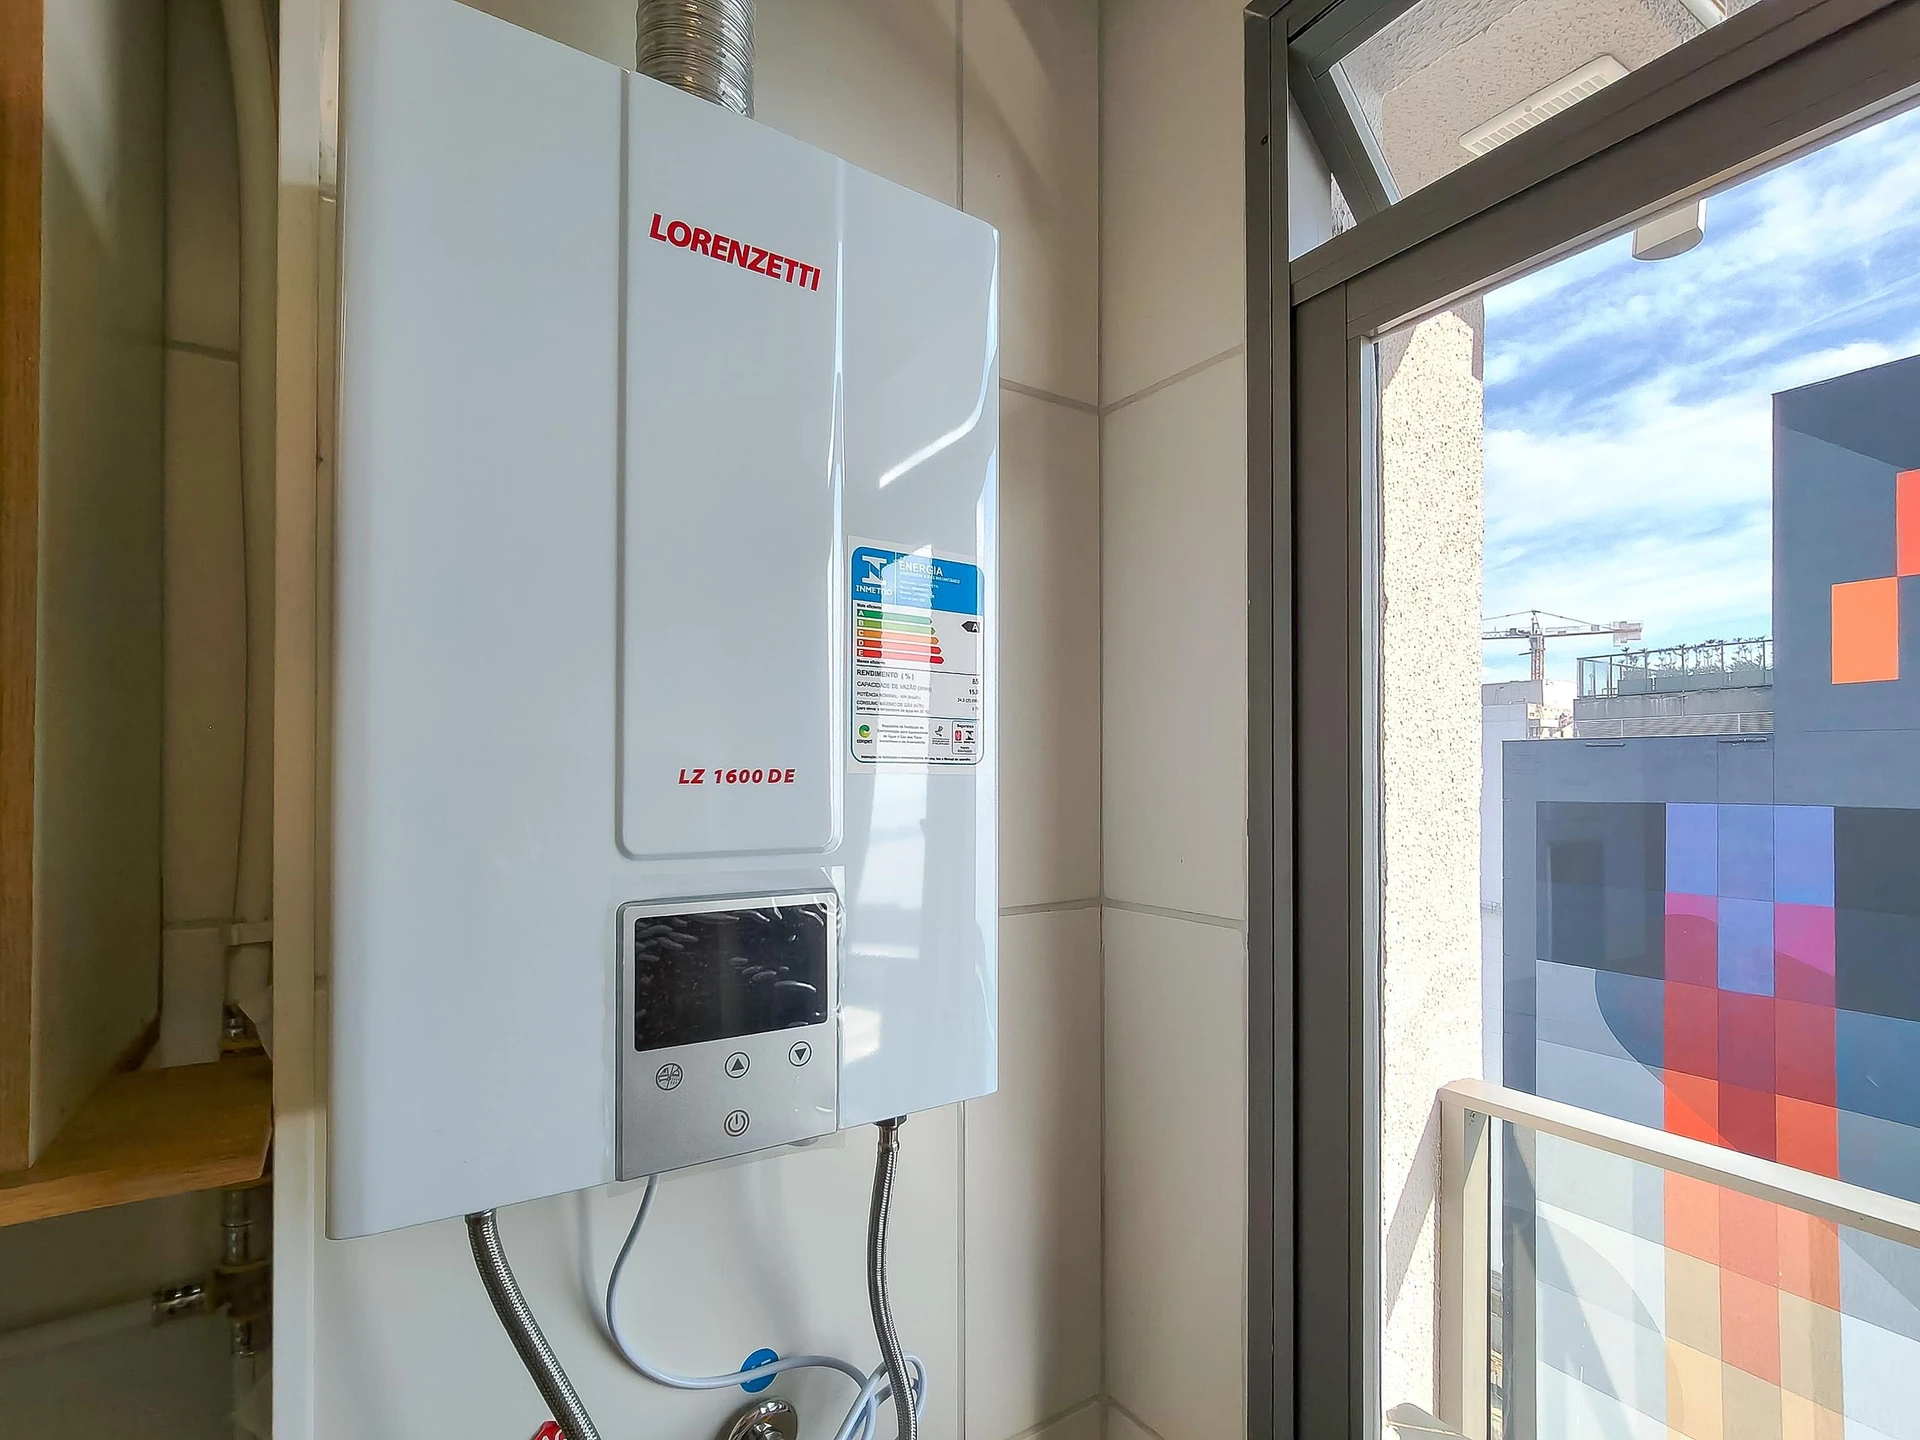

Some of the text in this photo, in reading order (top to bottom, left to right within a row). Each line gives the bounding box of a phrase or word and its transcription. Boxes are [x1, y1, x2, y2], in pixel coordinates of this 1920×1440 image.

[649, 213, 822, 292] LORENZETTI
[900, 560, 944, 576] ENERGIA
[972, 623, 979, 632] A
[856, 669, 898, 678] RENDIMENTO
[678, 768, 796, 784] LZ 1600 DE
